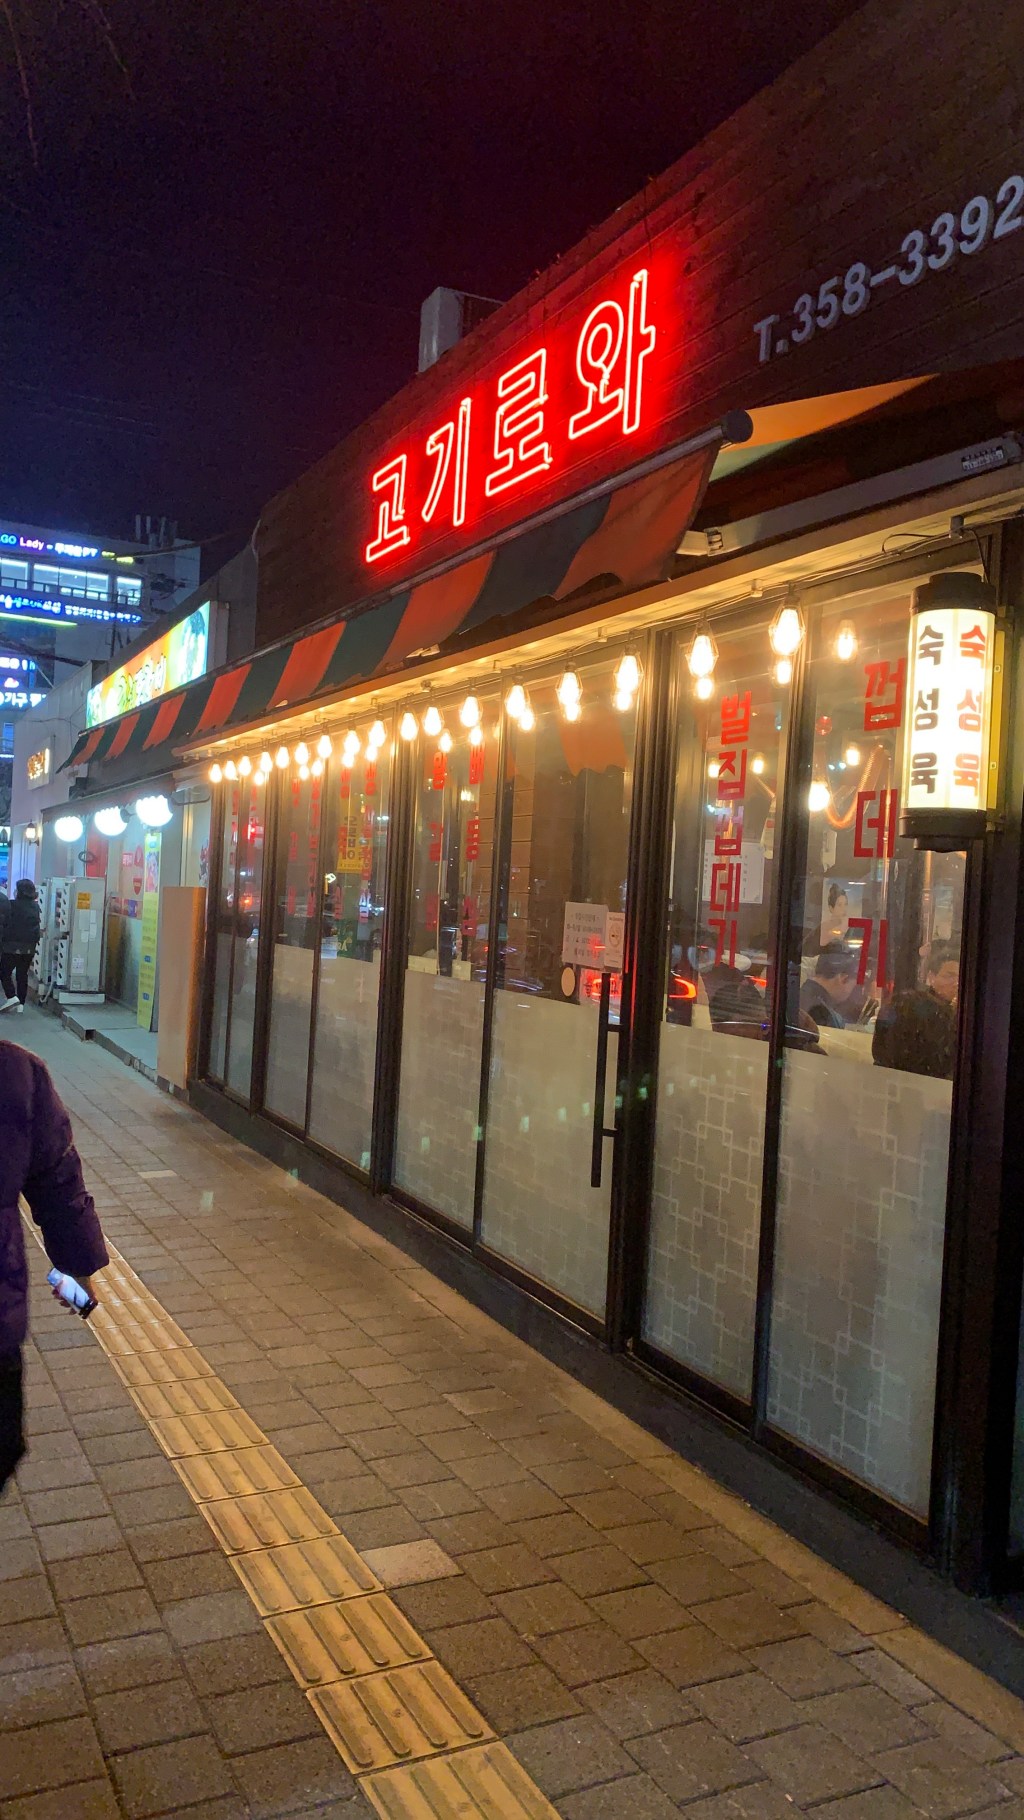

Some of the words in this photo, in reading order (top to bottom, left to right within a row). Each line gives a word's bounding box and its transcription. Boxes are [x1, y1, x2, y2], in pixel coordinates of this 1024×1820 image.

[366, 269, 656, 562] 고기로와
[20, 537, 44, 551] Lady
[911, 625, 944, 794] 숙성육
[953, 625, 986, 797] 숙성육
[708, 690, 751, 969] 벌집껍데기
[848, 657, 906, 988] 껍데기
